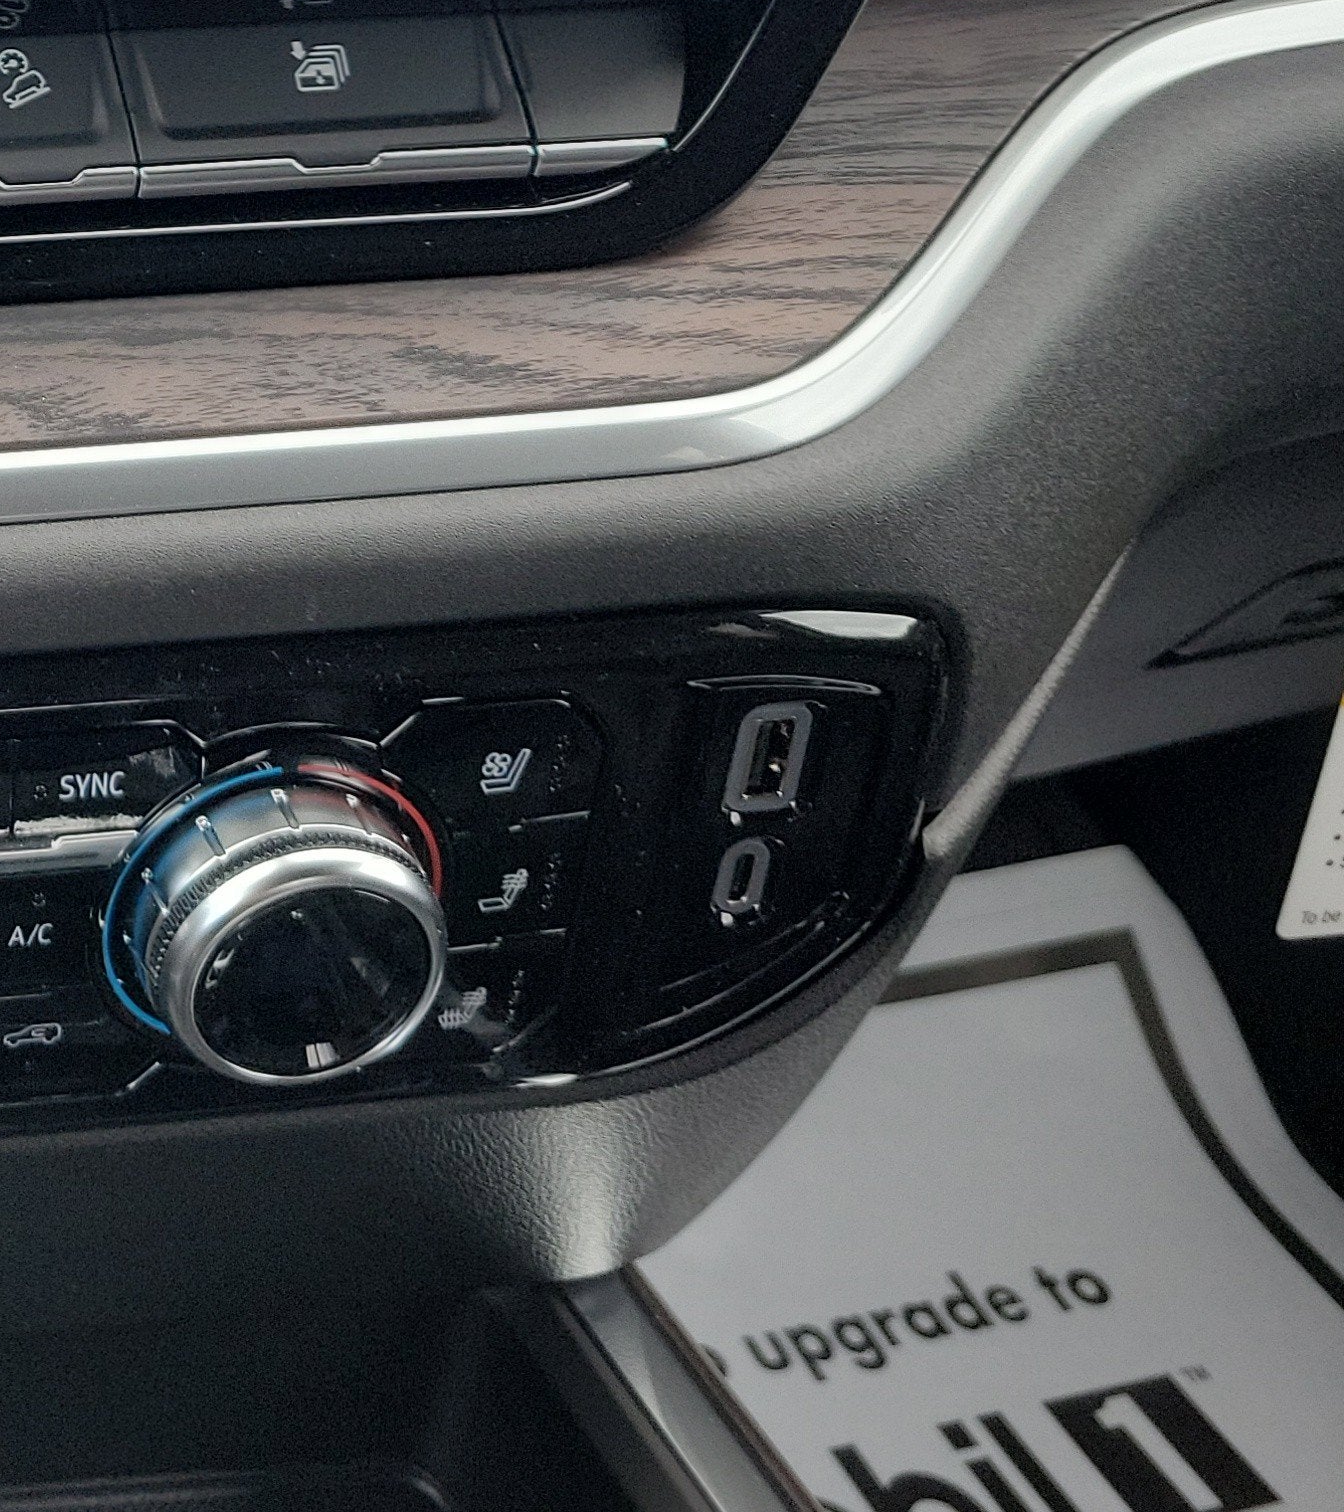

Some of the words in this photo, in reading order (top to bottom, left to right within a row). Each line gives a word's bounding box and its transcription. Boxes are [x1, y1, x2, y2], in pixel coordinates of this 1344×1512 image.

[58, 770, 124, 800] SYNC
[8, 922, 53, 948] A/C
[742, 1270, 1030, 1382] upgrade
[1032, 1265, 1110, 1311] to
